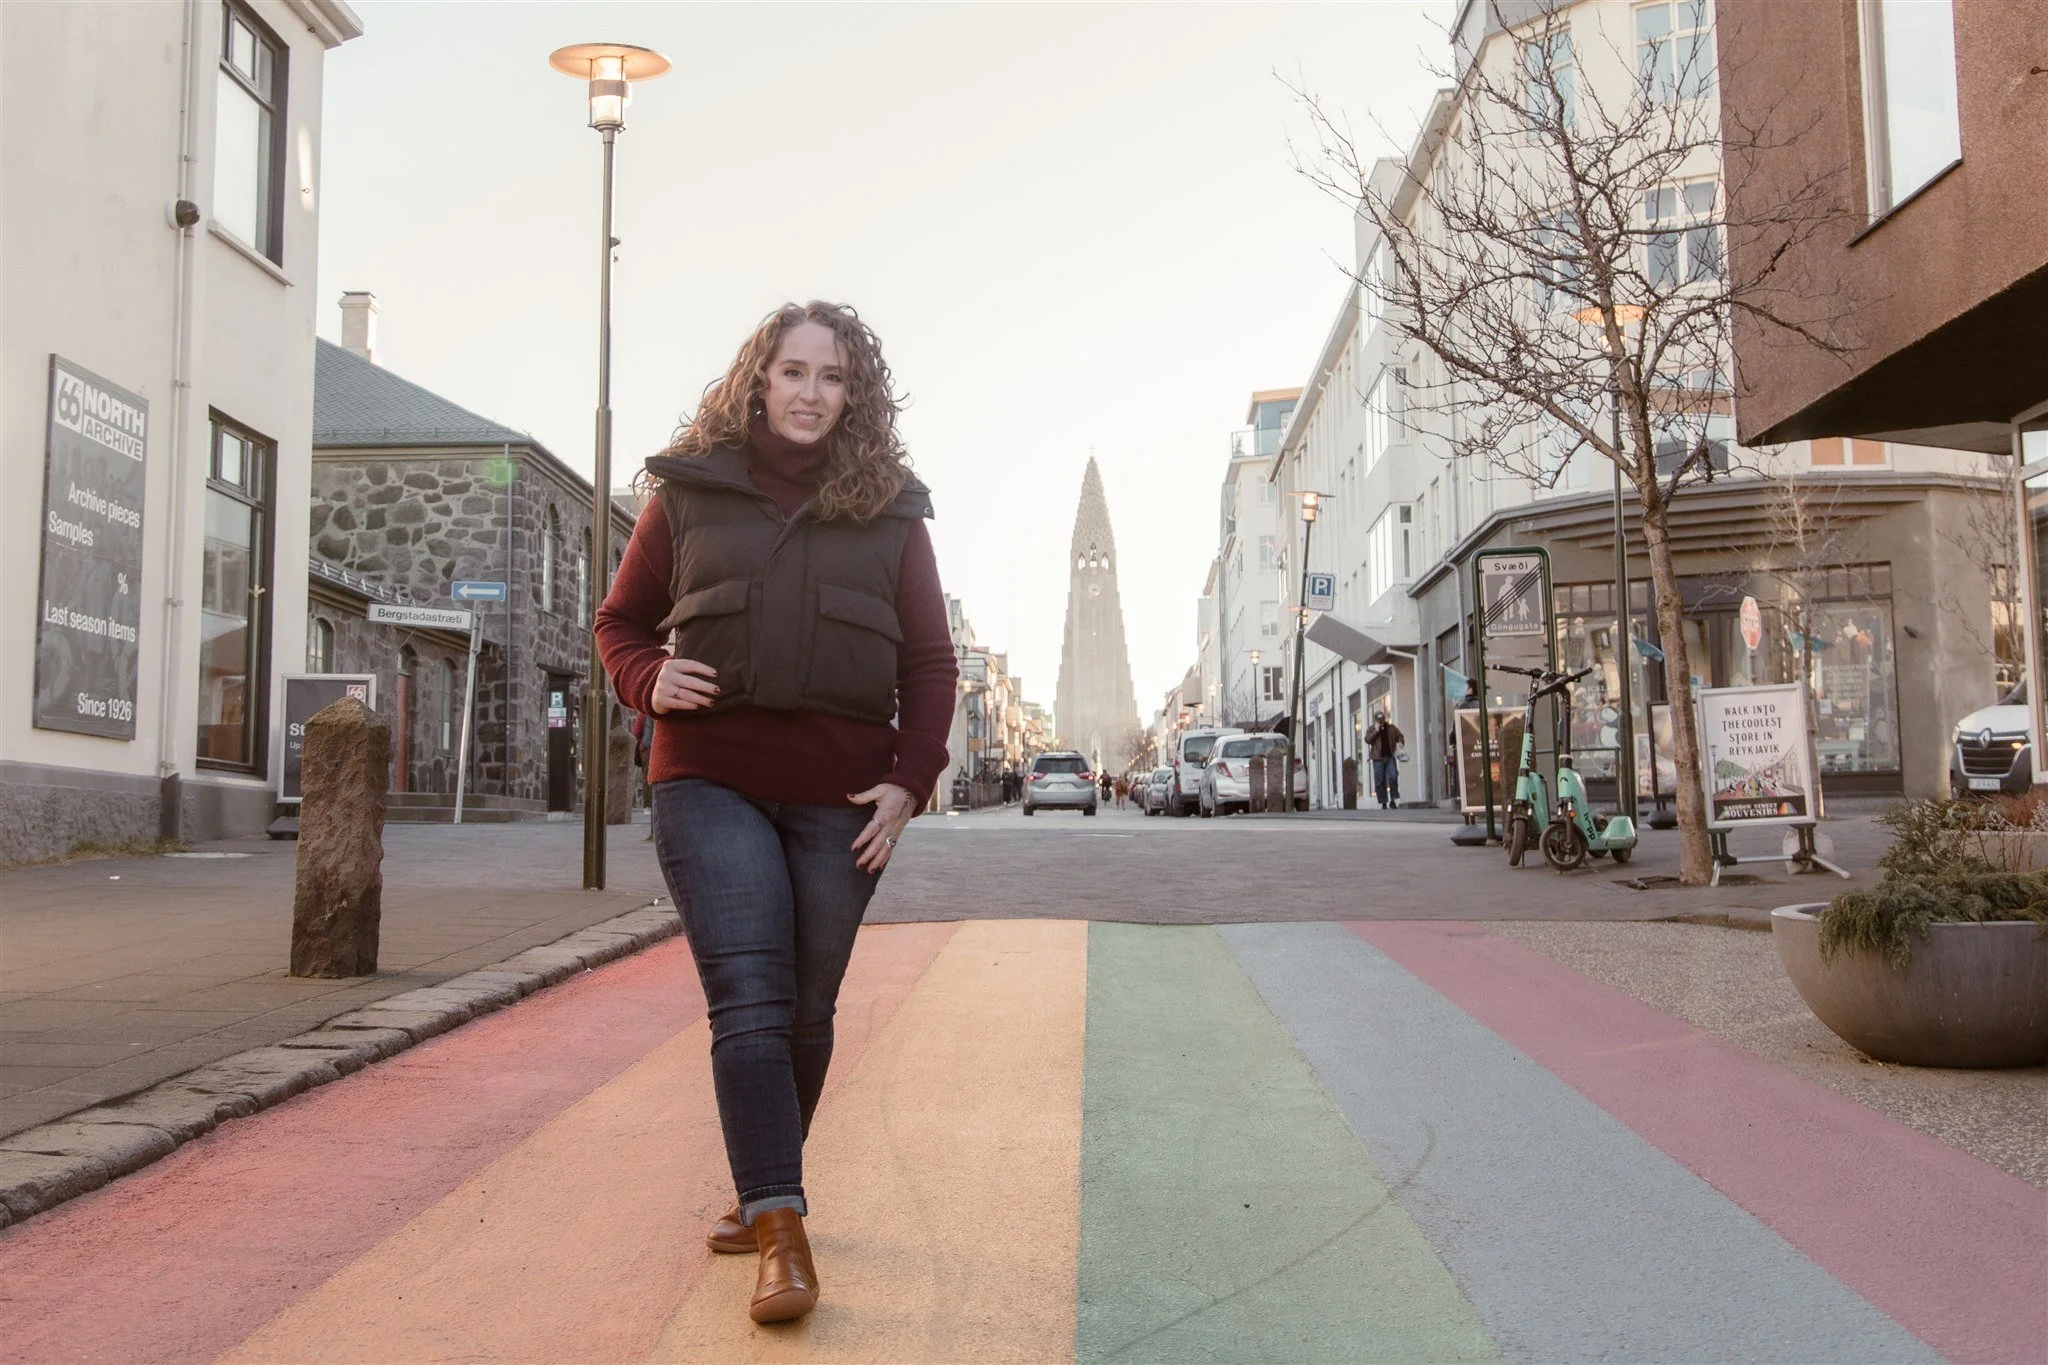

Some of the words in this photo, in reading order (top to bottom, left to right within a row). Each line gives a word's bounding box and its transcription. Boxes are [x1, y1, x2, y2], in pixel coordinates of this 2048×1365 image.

[84, 384, 145, 437] NORTH
[85, 418, 142, 460] ARCHIVE
[68, 481, 107, 515] Archive
[107, 500, 140, 528] pieces
[48, 510, 94, 546] Samples
[117, 572, 129, 595] %
[45, 599, 68, 626] Last
[69, 611, 107, 636] season
[108, 616, 136, 642] items
[77, 692, 106, 718] Since
[107, 698, 132, 721] 1926
[1724, 705, 1749, 717] WALK
[1753, 703, 1776, 716] INTO
[289, 741, 301, 750] Up
[1729, 731, 1760, 745] STORE
[1763, 731, 1773, 741] IN
[1729, 744, 1780, 756] REYKJAVIK
[1725, 807, 1778, 818] SOUVENIRS
